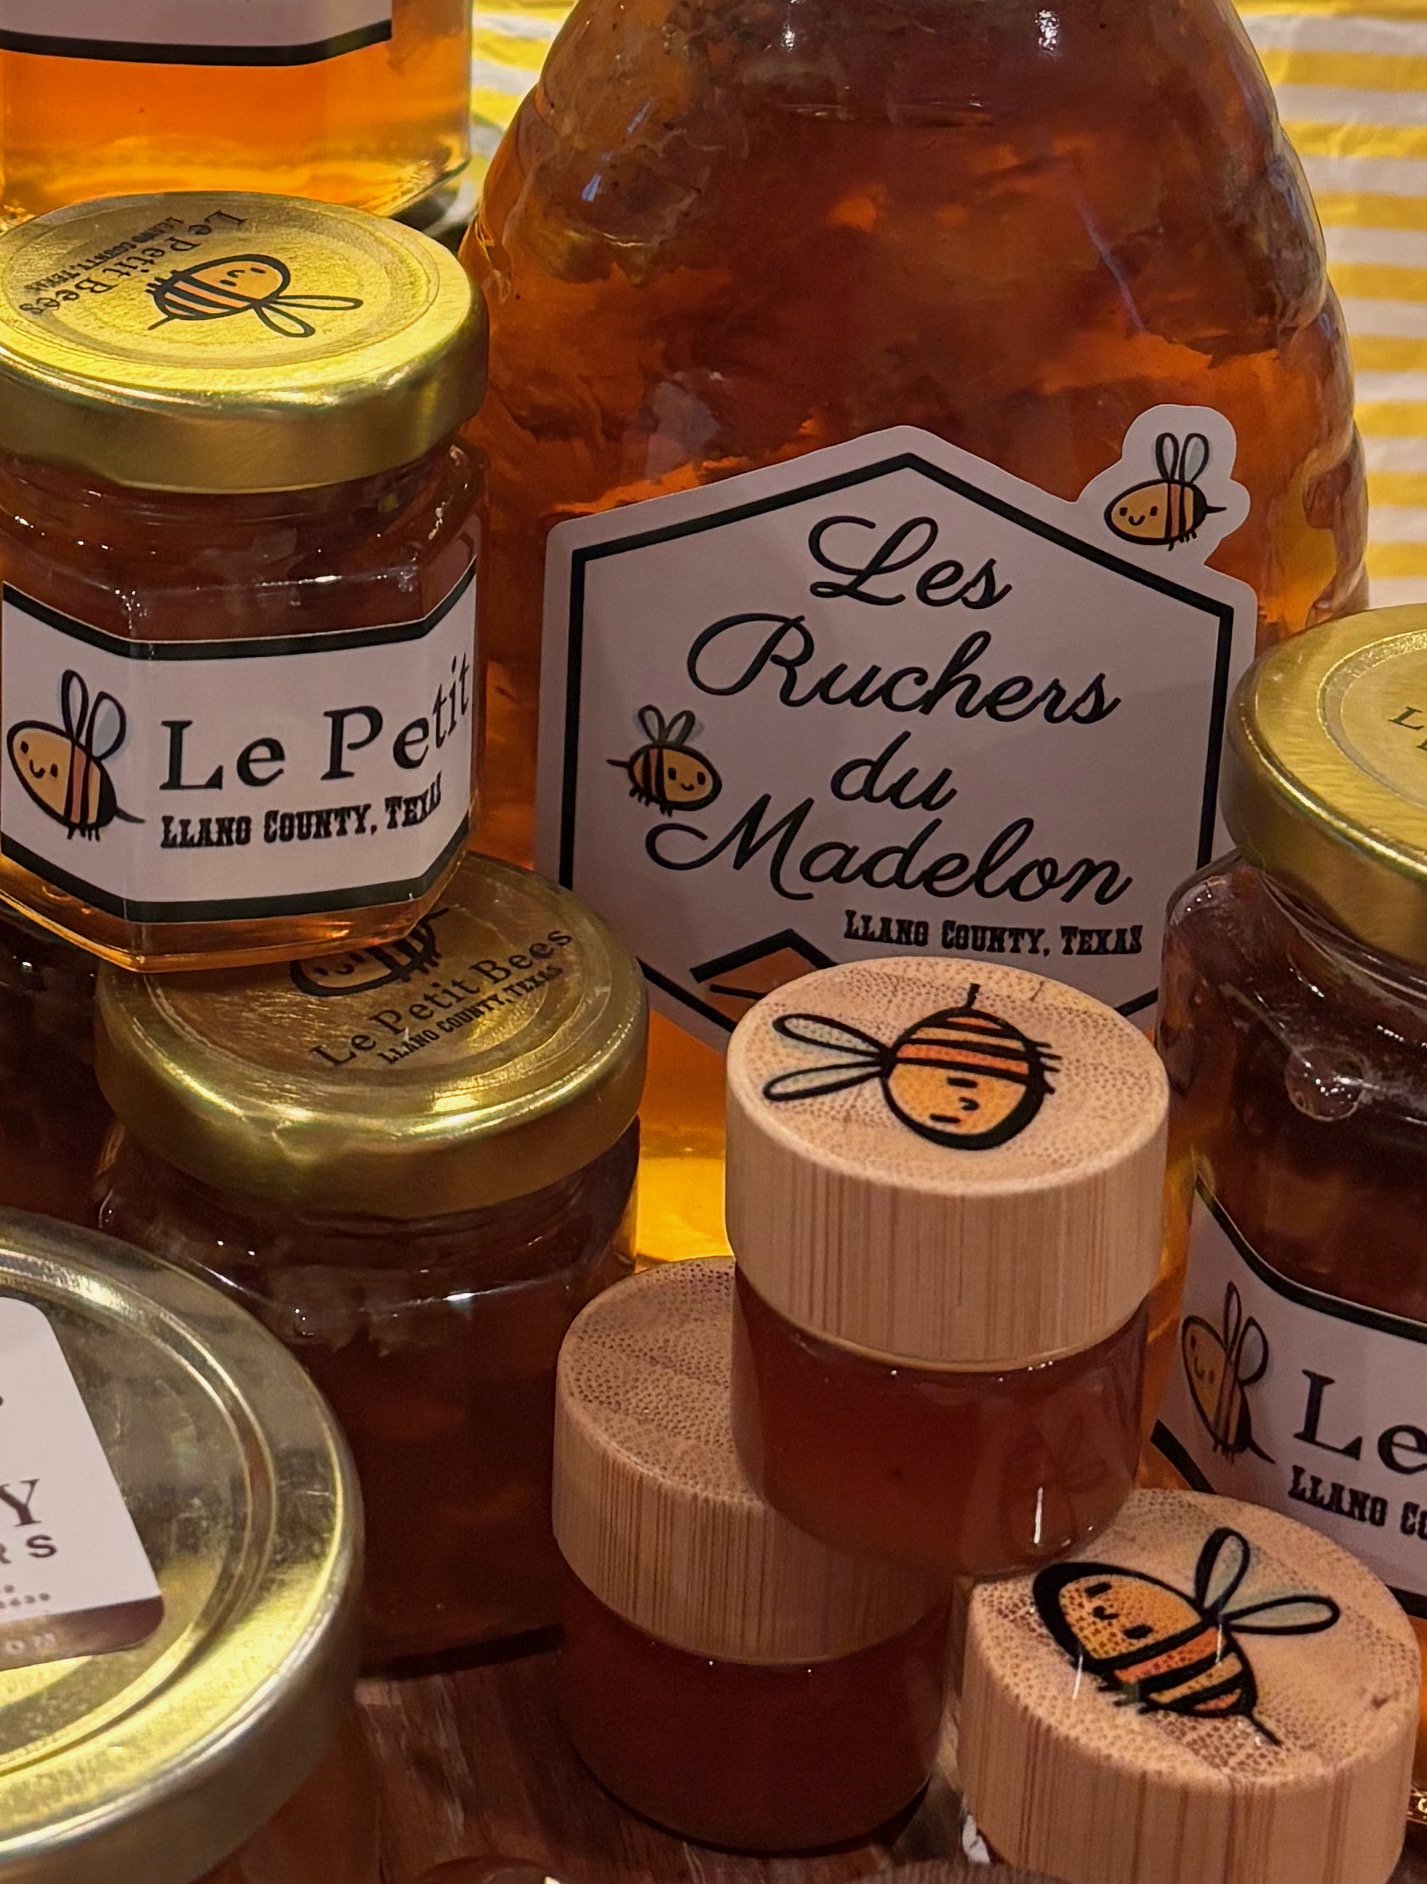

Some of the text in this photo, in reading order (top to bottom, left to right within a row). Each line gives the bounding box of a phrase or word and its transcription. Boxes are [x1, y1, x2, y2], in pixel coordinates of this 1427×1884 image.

[19, 209, 247, 315] Le Petit Bees
[807, 514, 1012, 608] Les
[159, 652, 470, 791] Le Petit
[686, 612, 1122, 725] Ruchers
[829, 730, 959, 811] du
[644, 793, 1133, 907] Madelon
[310, 929, 573, 1067] Le Petit Bees
[1293, 1369, 1427, 1475] Le
